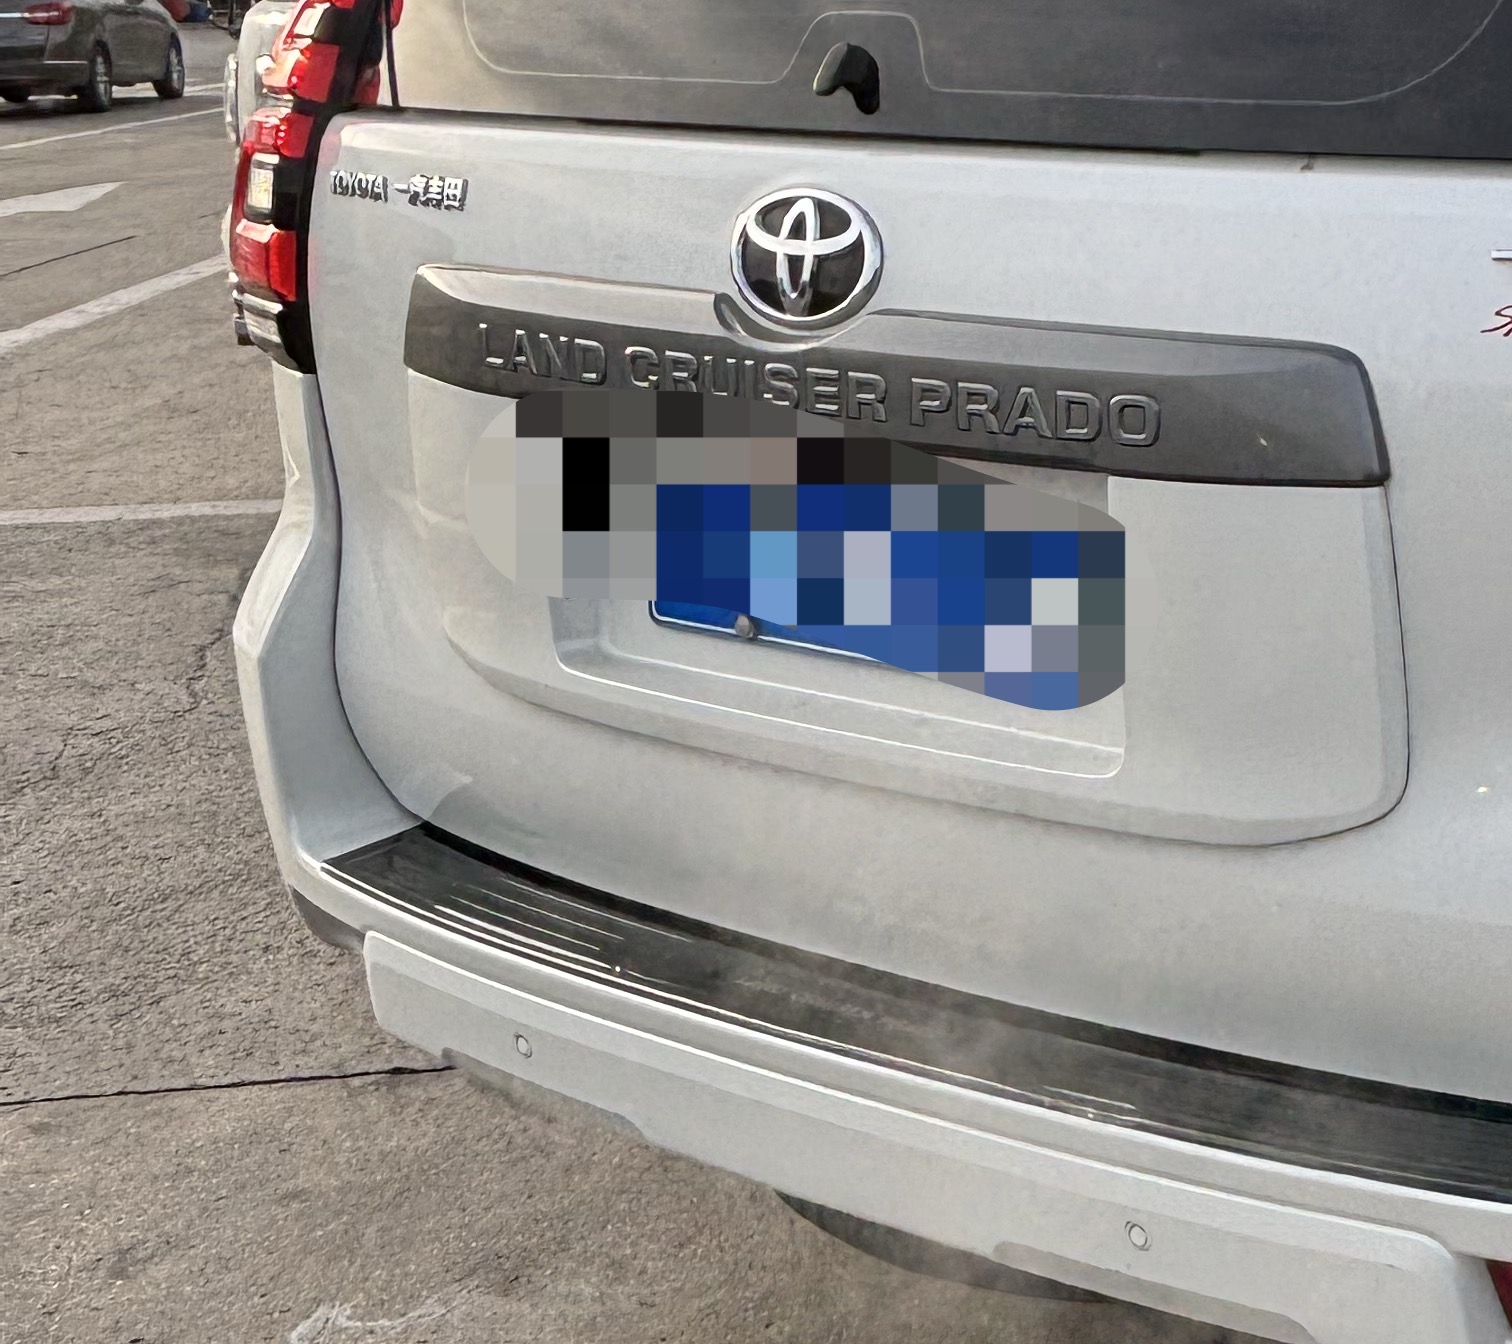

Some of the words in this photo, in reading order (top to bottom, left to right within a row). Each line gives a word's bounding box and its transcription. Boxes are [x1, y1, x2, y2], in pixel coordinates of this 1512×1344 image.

[329, 170, 388, 203] TOYOTA
[478, 322, 607, 387] LAND
[624, 345, 888, 424] CRUISER
[910, 376, 1162, 447] PRADO
